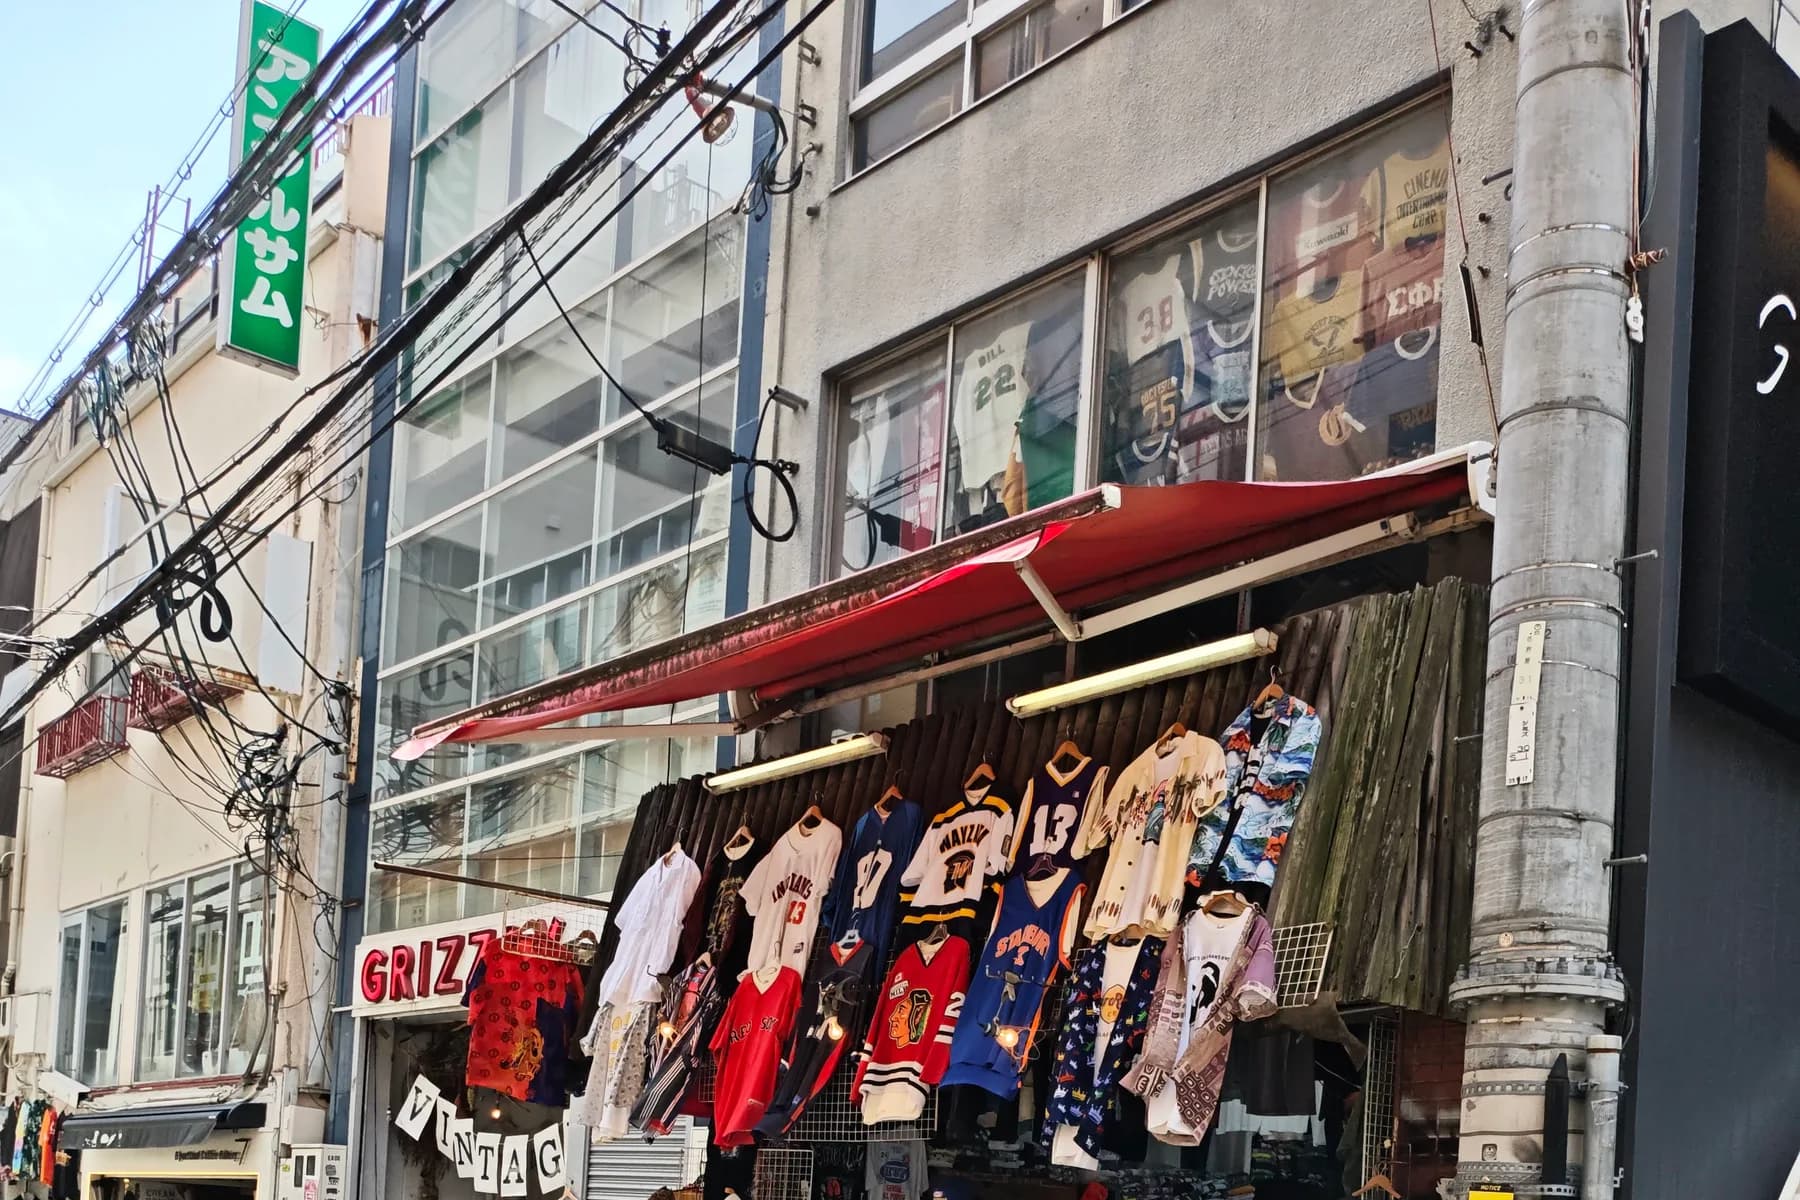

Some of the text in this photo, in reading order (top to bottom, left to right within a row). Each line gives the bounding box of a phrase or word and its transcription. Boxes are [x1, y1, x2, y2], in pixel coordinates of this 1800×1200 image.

[973, 363, 1017, 413] 22
[1029, 804, 1078, 857] 13
[944, 991, 966, 1018] 2
